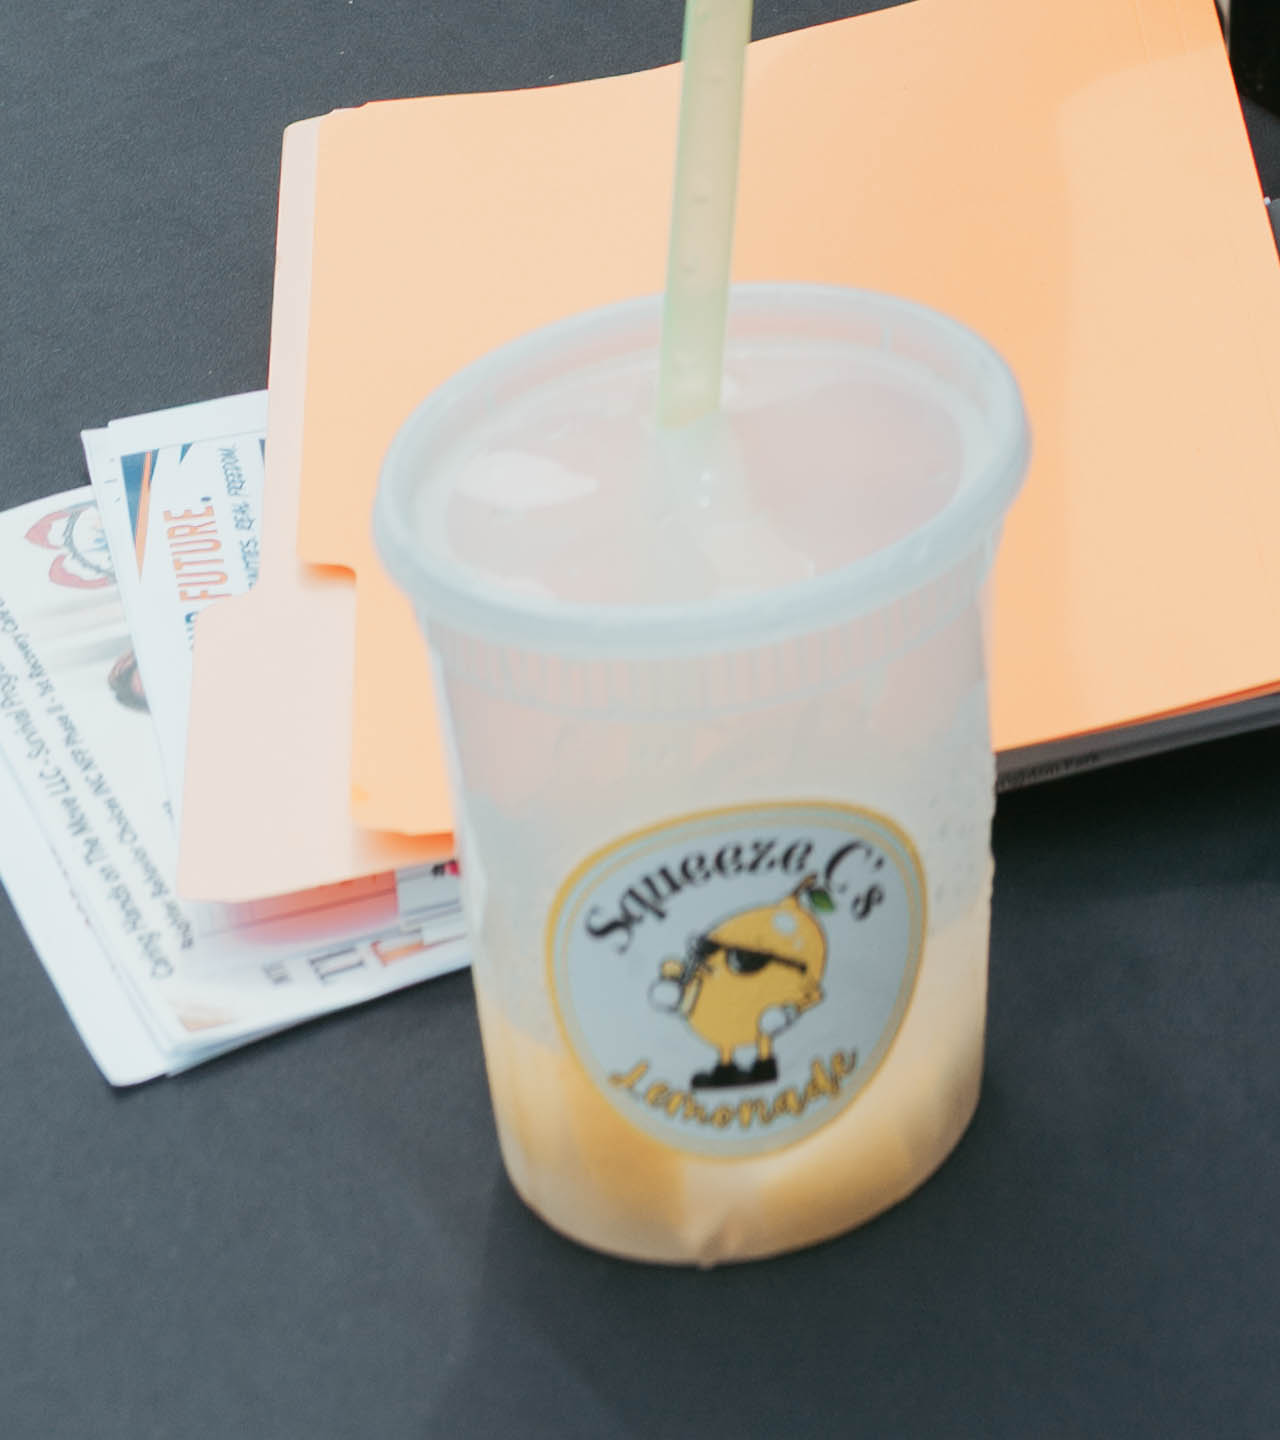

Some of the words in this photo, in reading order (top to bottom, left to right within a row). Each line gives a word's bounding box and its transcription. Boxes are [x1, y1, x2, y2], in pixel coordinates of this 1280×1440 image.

[62, 796, 92, 837] Move
[83, 836, 107, 866] The
[108, 883, 142, 933] Hands
[585, 836, 814, 955] Squeeze
[608, 1048, 858, 1129] Lemonade
